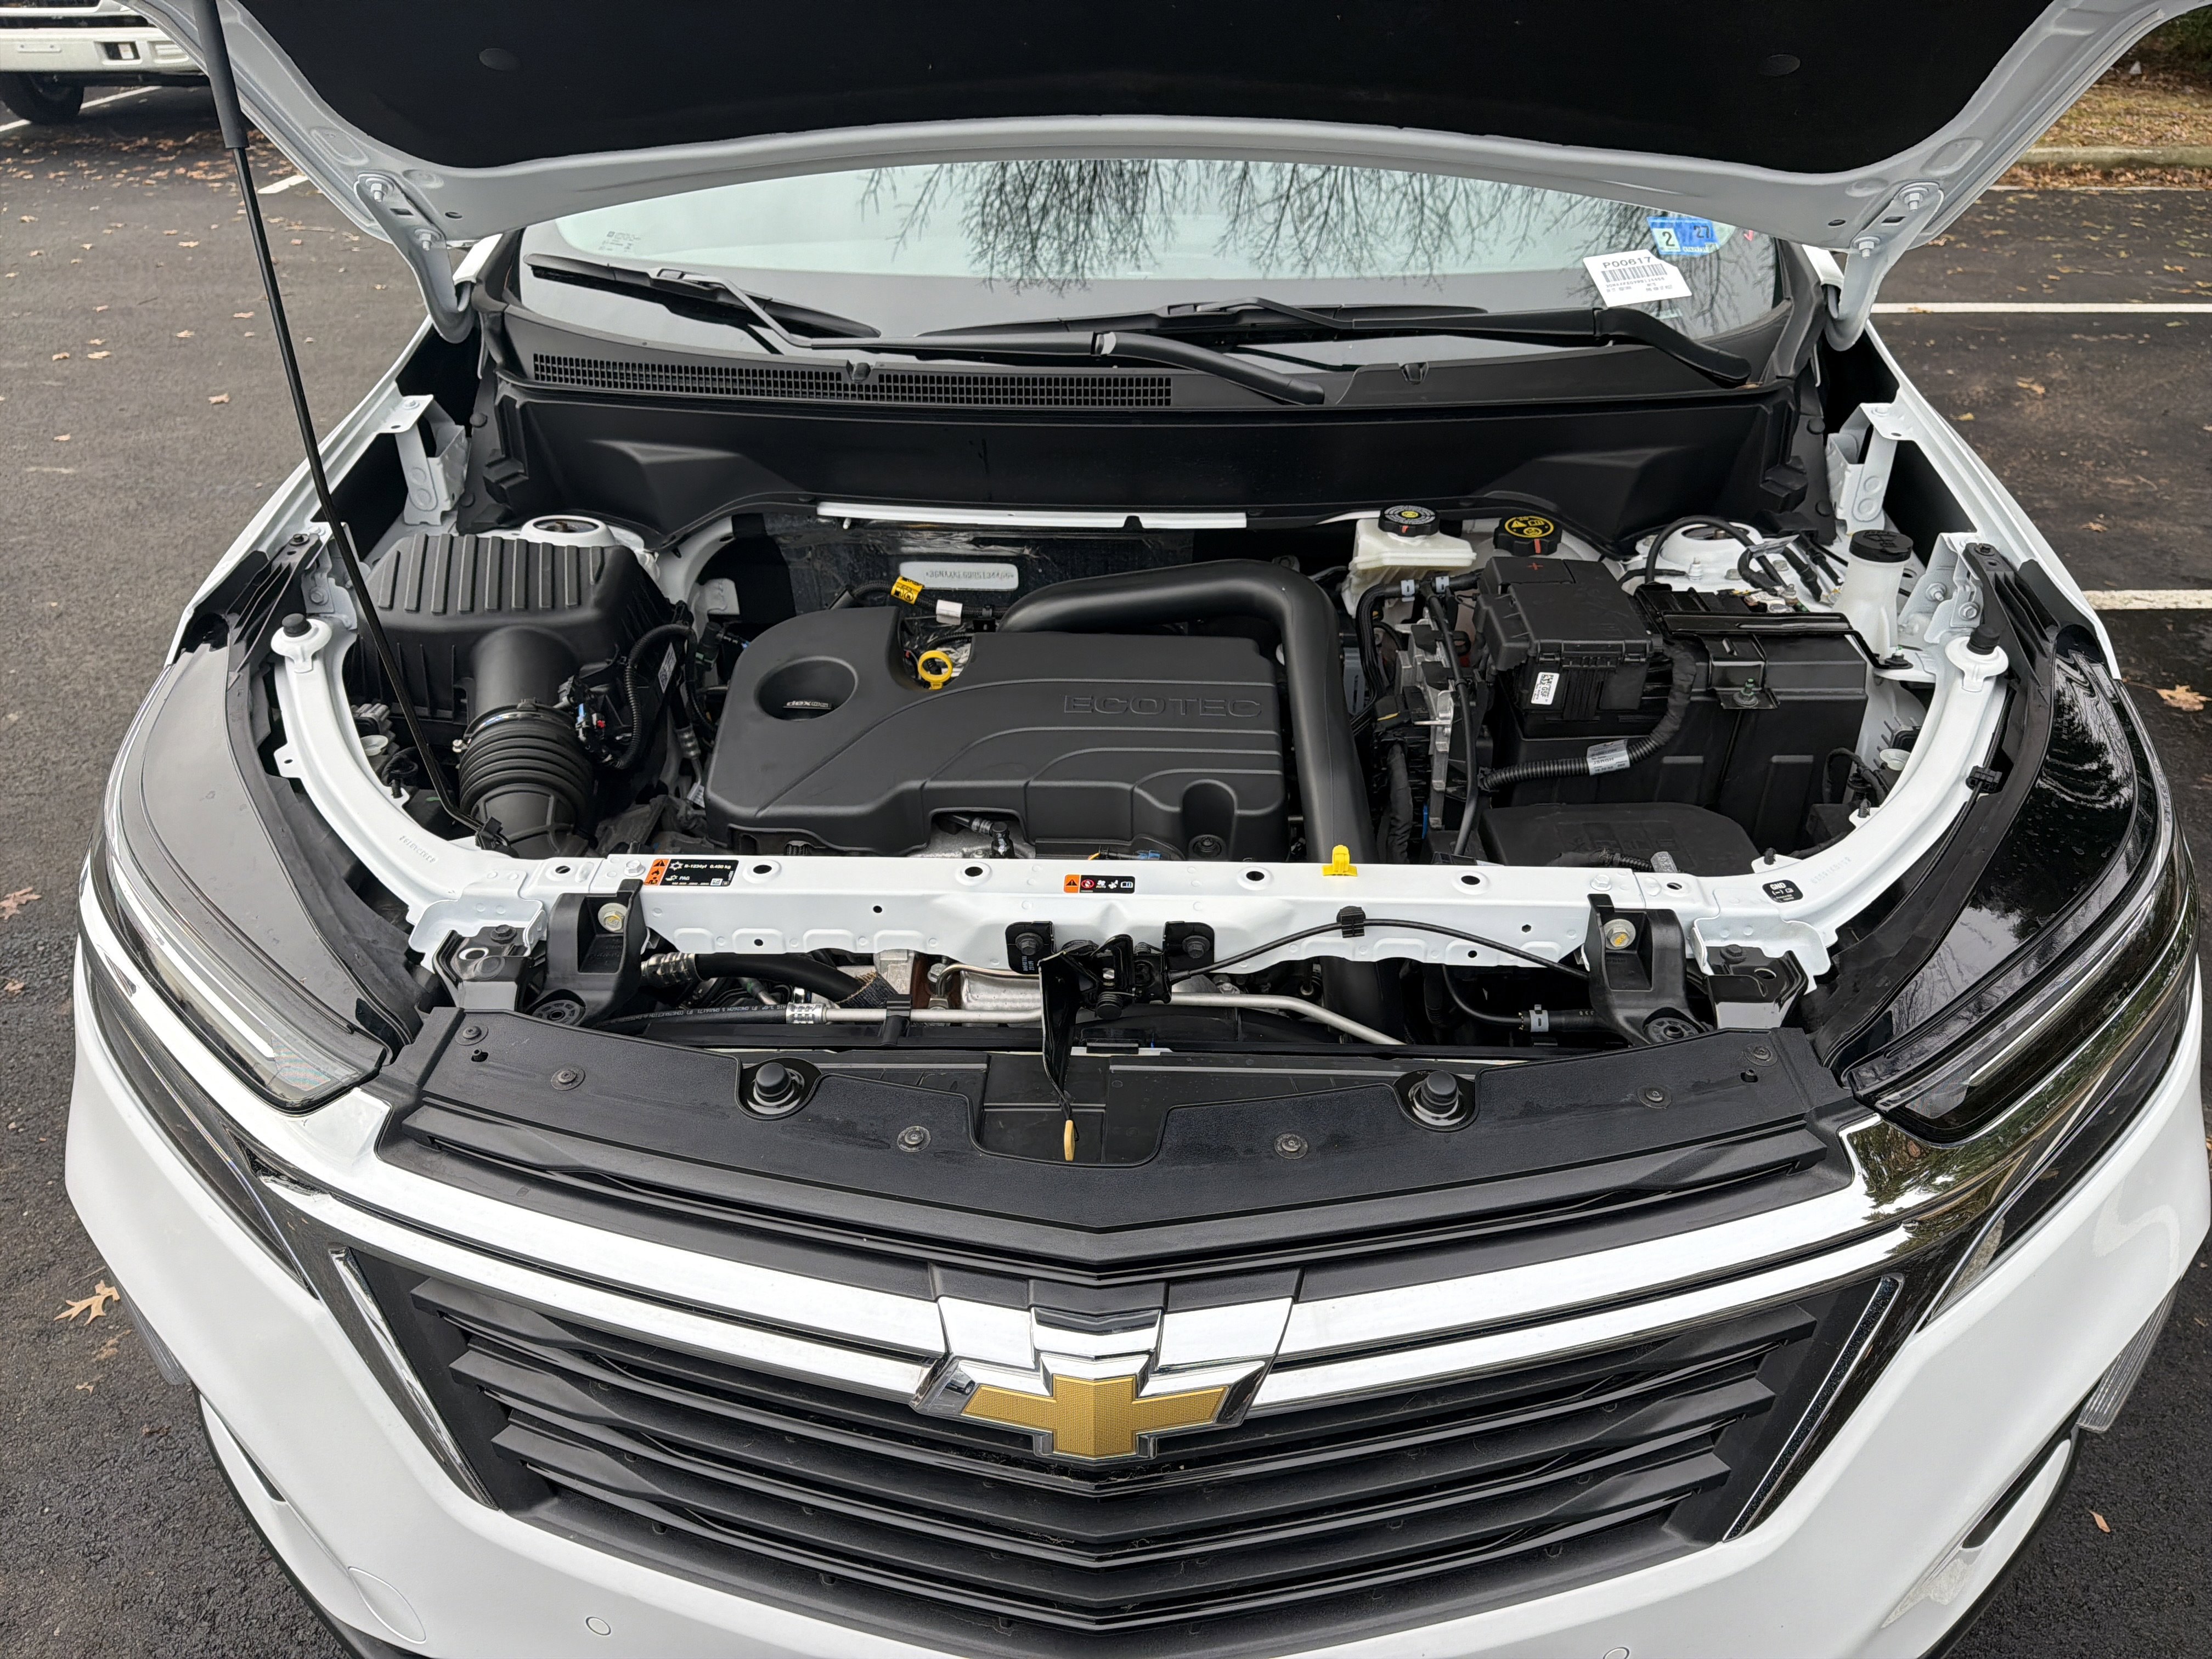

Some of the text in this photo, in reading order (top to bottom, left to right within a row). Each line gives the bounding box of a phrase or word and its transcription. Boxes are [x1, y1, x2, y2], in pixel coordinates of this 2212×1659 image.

[1662, 231, 1675, 246] 2
[1694, 225, 1709, 238] 27
[1064, 695, 1262, 717] ECOTEC
[1769, 882, 1786, 890] GND
